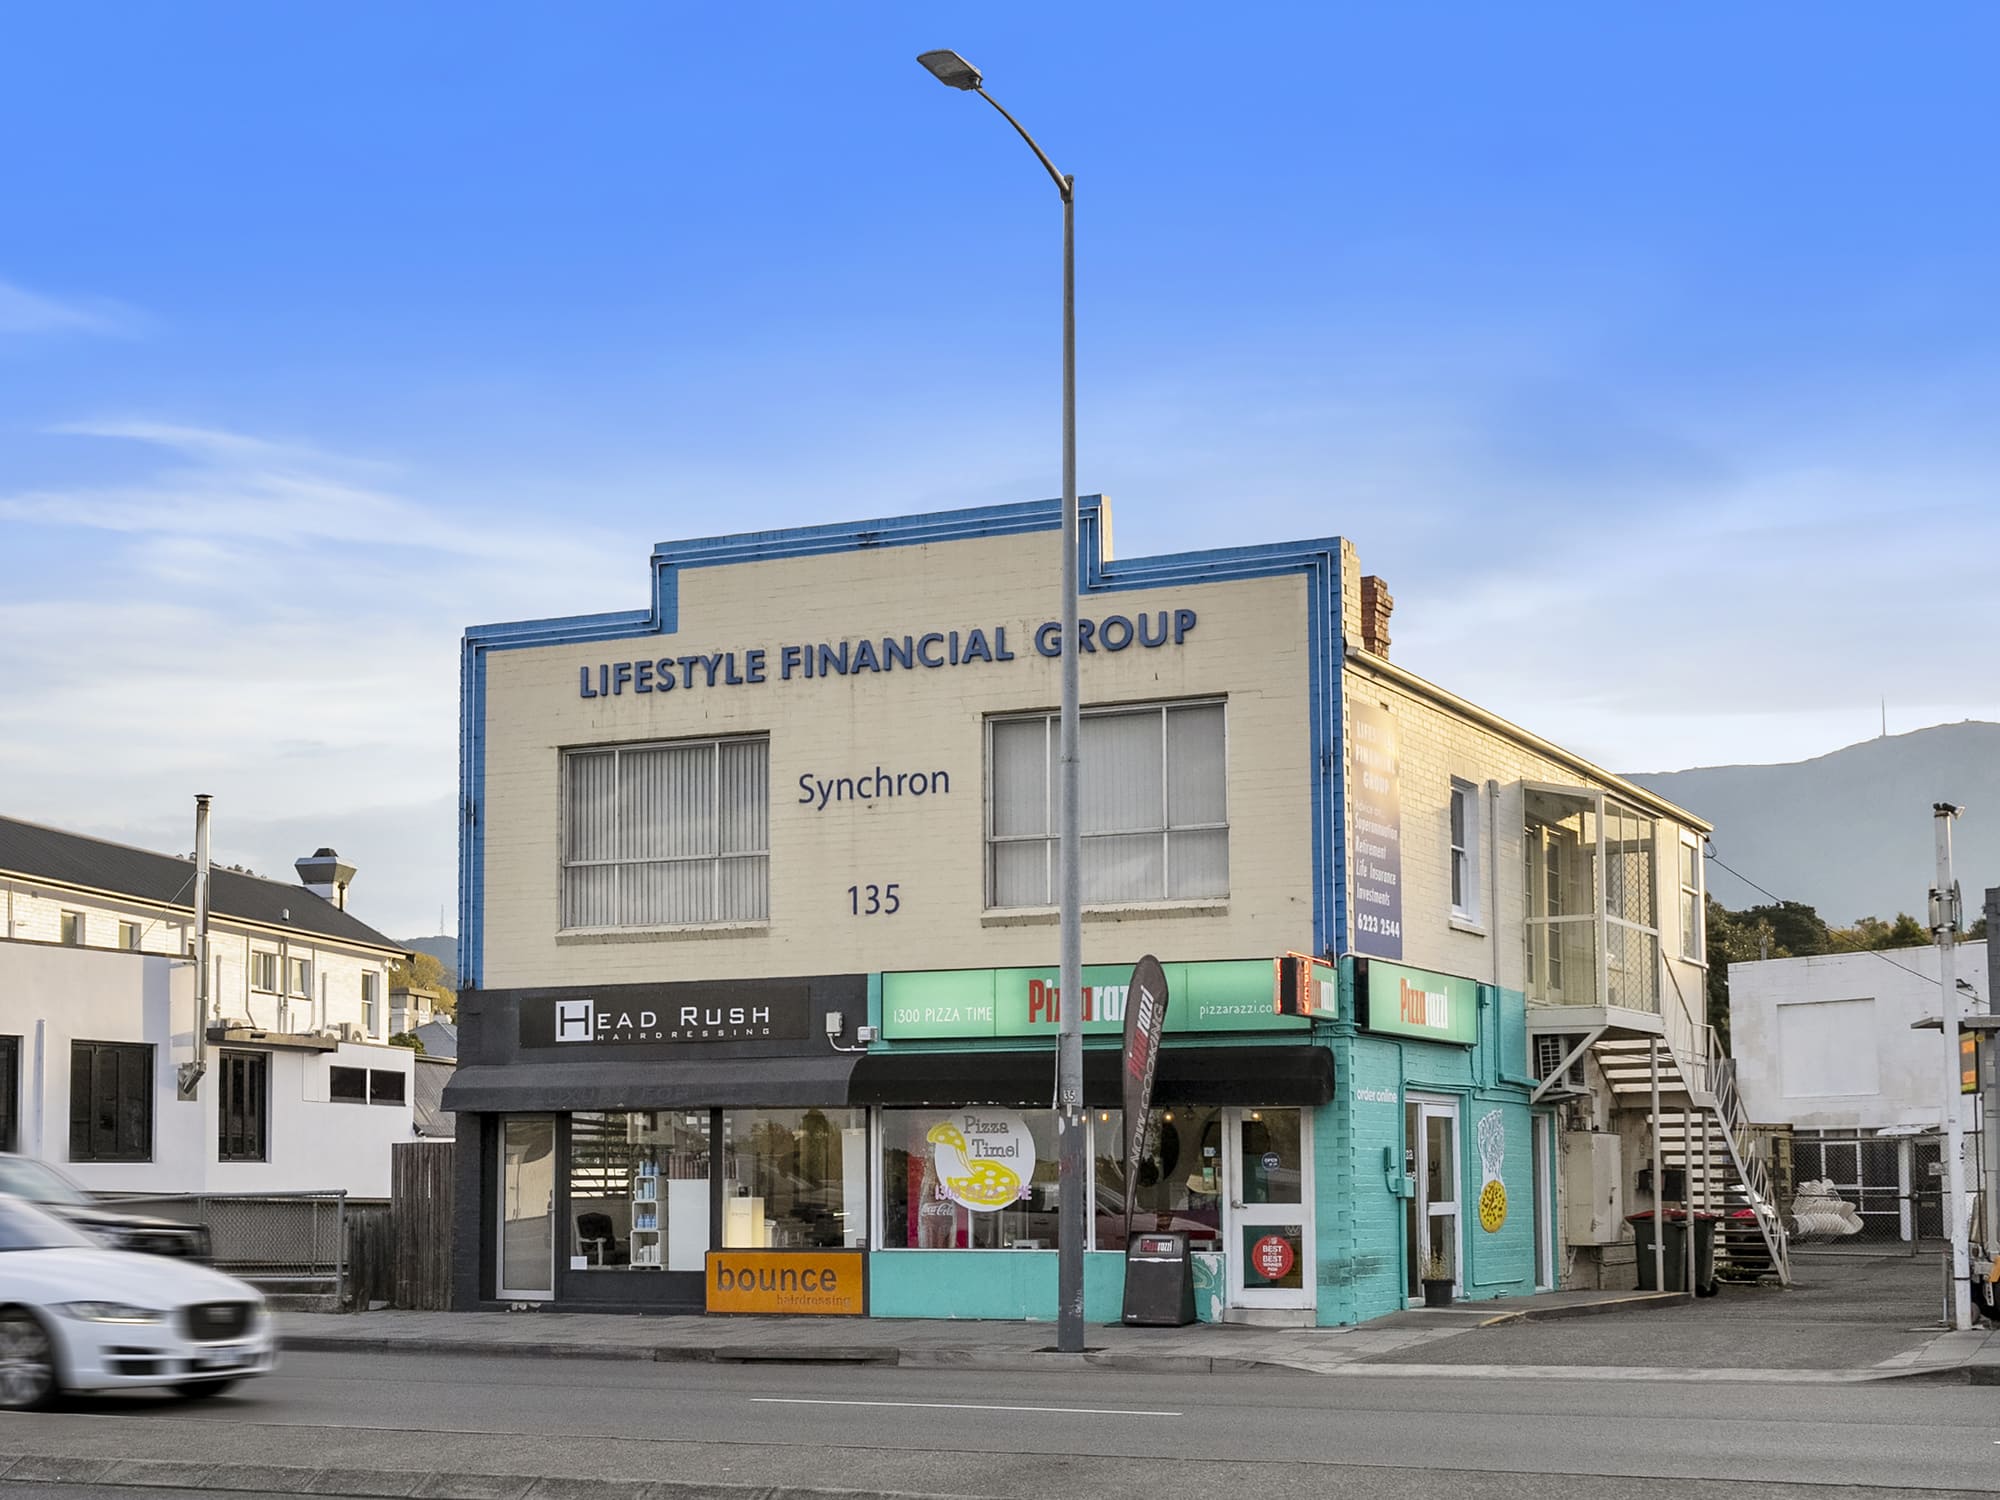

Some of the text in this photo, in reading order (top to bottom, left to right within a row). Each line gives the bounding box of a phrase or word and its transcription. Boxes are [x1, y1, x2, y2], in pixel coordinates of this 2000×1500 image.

[580, 609, 1198, 699] LIFESTYLE FINANCIAL GROUP
[798, 766, 950, 811] Synchron
[1356, 857, 1368, 878] Life
[847, 883, 900, 916] 135
[1357, 913, 1401, 938] 6223 2544
[680, 1006, 769, 1026] RUSH
[893, 1006, 993, 1023] 1300 PIZZA TIME
[1200, 1001, 1273, 1020] pizzarazzi.co
[597, 1027, 770, 1041] HAIRDRESSING
[1356, 1087, 1376, 1101] order
[963, 1115, 1010, 1134] Pizza
[1262, 1245, 1284, 1253] BEST
[1262, 1255, 1284, 1263] BEST
[716, 1259, 838, 1292] bounce
[776, 1294, 851, 1307] hairdressing
